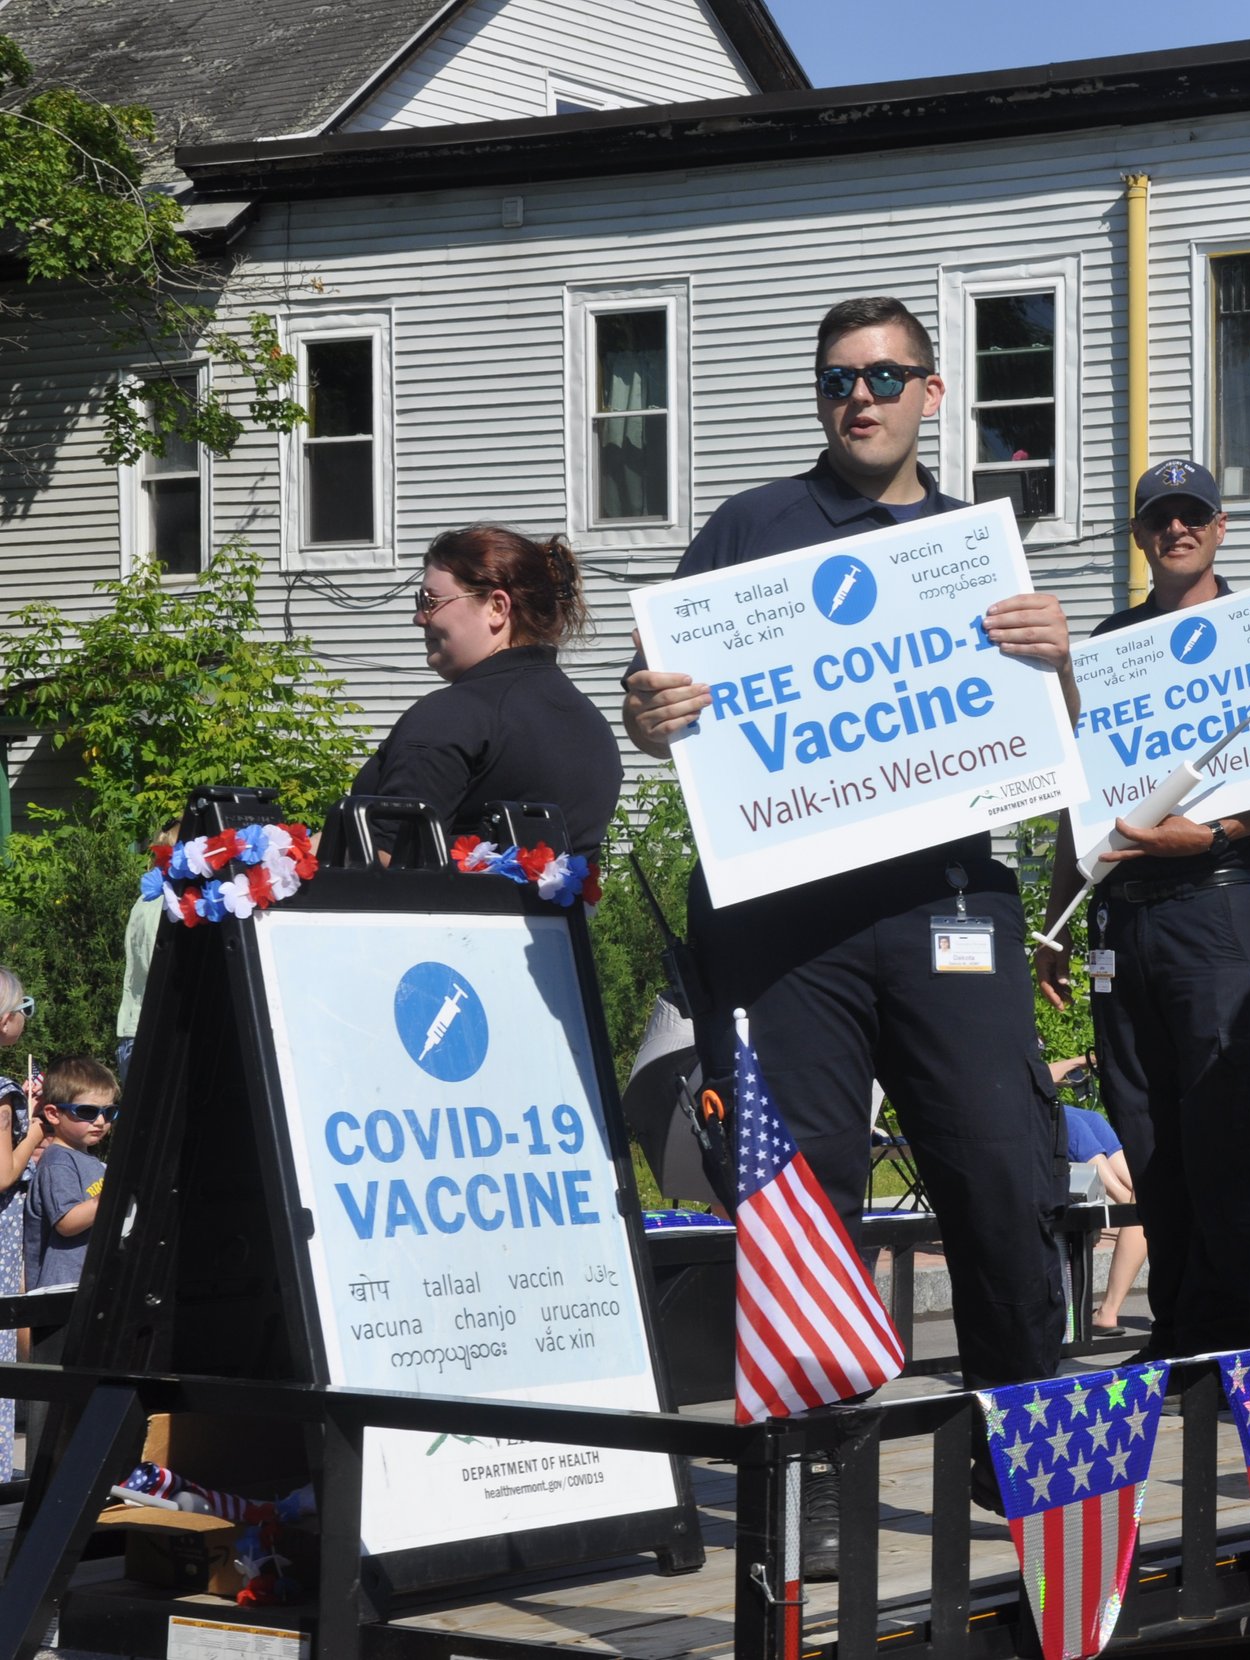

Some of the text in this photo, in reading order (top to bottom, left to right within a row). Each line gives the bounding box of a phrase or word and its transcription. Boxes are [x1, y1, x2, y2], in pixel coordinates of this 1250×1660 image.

[889, 541, 943, 565] vaccin
[911, 553, 990, 584] urucanco
[735, 578, 789, 604] tallaal
[670, 599, 806, 644] vacuna chanjo
[723, 625, 785, 651] vắc xin
[1115, 635, 1154, 656] tallaal
[687, 614, 1001, 729] REE COVID-1
[1074, 650, 1165, 683] acuna chanjo
[1129, 667, 1147, 680] xin
[739, 674, 996, 774] Vaccine
[739, 734, 1028, 833] Walk-ins Welcome
[1000, 771, 1057, 797] VERMONT
[988, 790, 1062, 816] DEPARTMENT OF HEALTH
[325, 1103, 585, 1166] COVID-19
[334, 1169, 601, 1241] VACCINE
[423, 1266, 564, 1298] tallaal vaccin
[350, 1299, 620, 1341] vacuna chanjo urucanco
[535, 1327, 595, 1353] vắc xin
[462, 1450, 600, 1482] DEPARTMENT OF HEALTH
